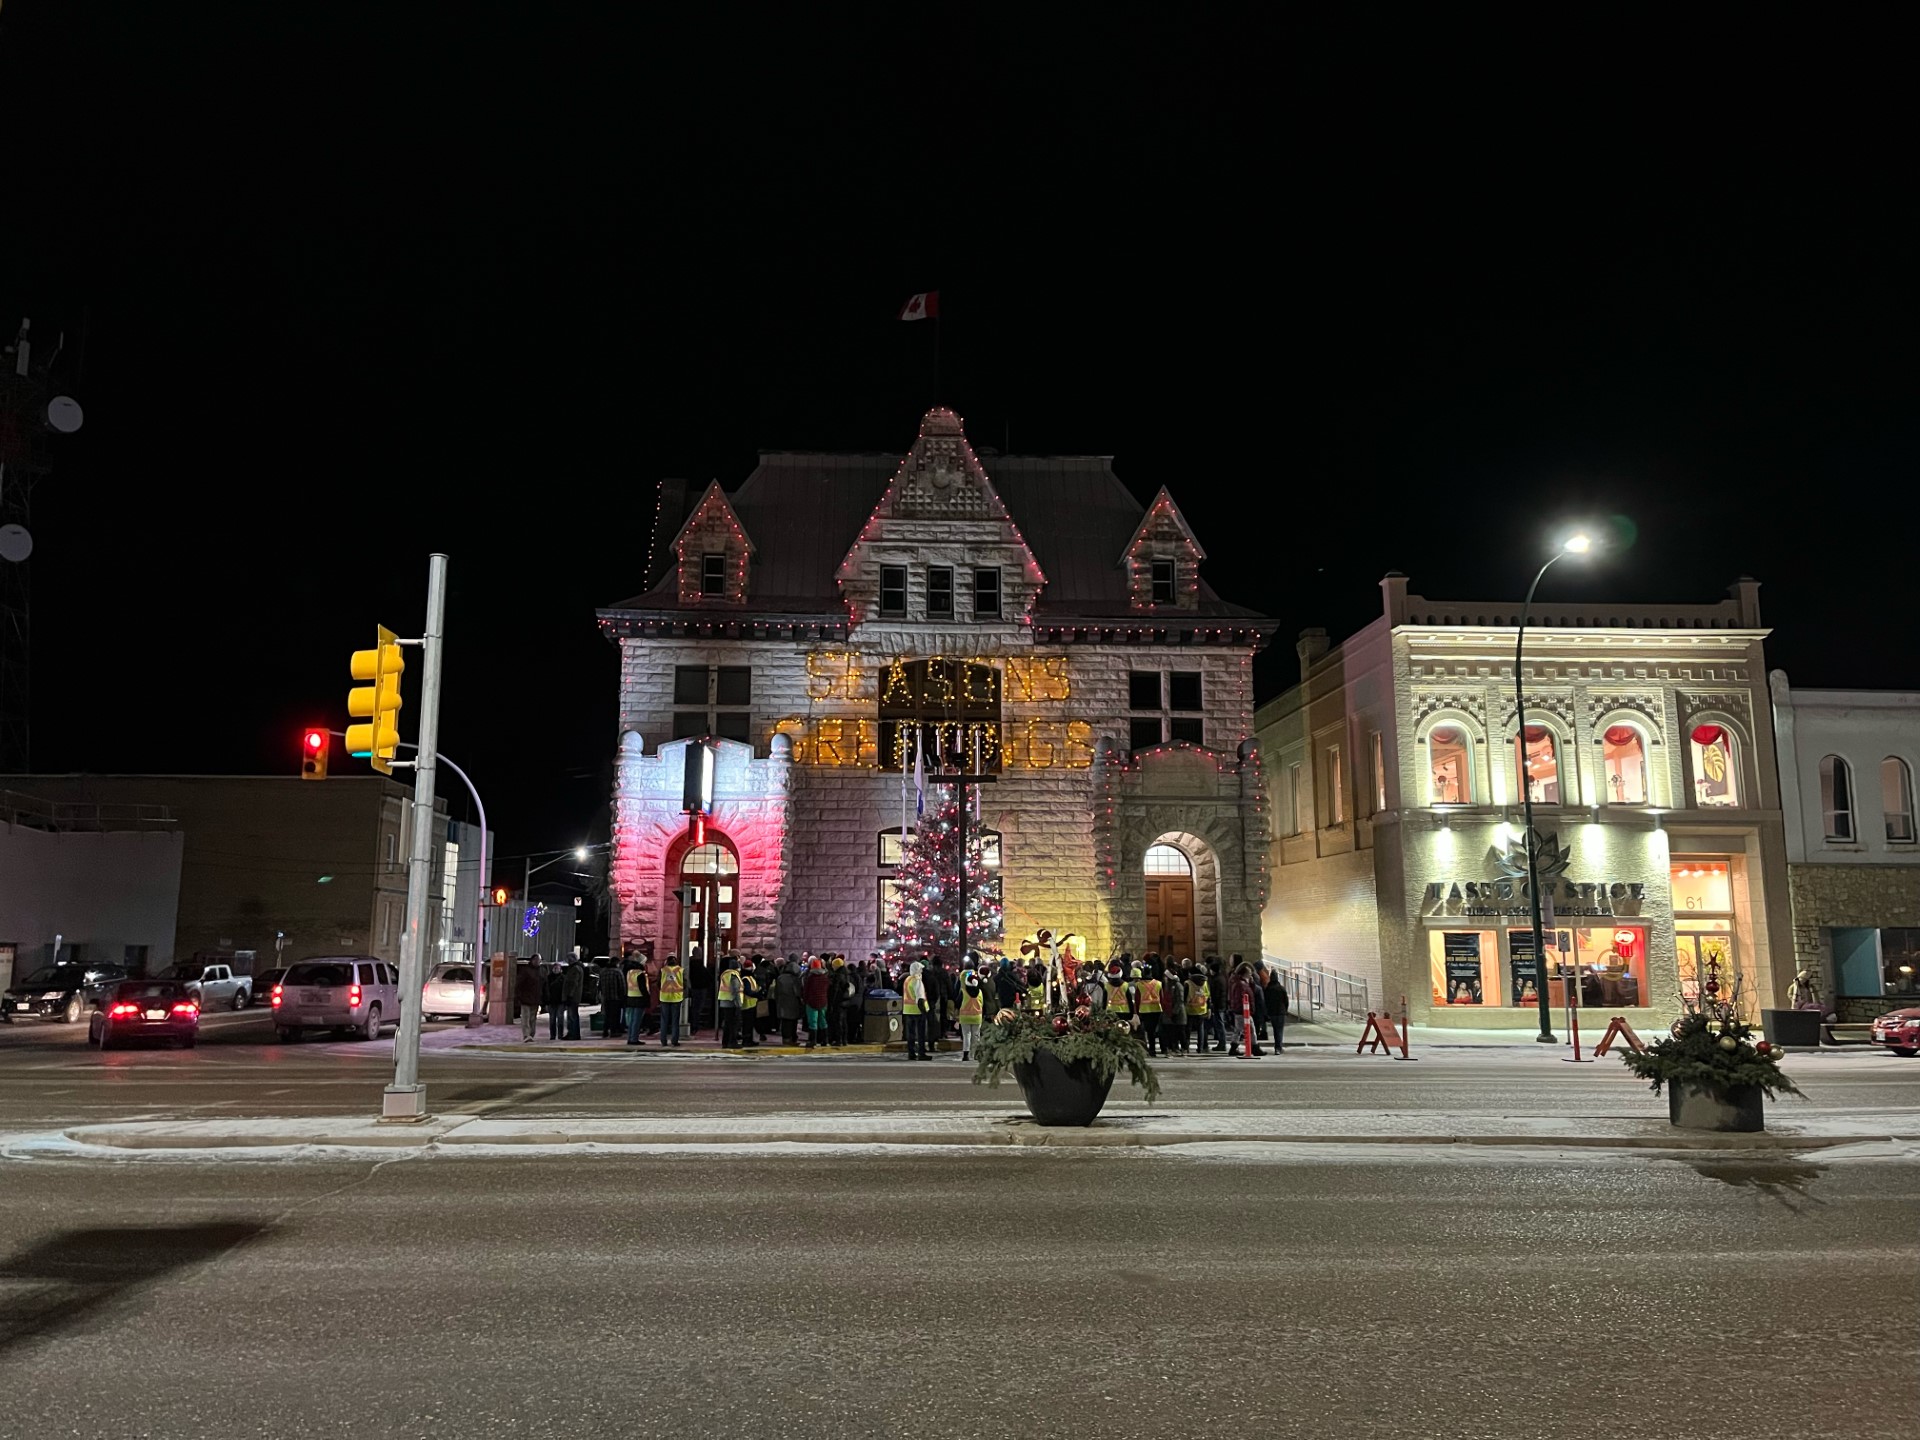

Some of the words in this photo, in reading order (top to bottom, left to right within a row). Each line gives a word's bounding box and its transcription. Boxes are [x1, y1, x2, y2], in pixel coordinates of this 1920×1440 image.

[806, 651, 1072, 703] SEASONS
[1564, 882, 1645, 900] SPICE
[1685, 896, 1703, 910] 61
